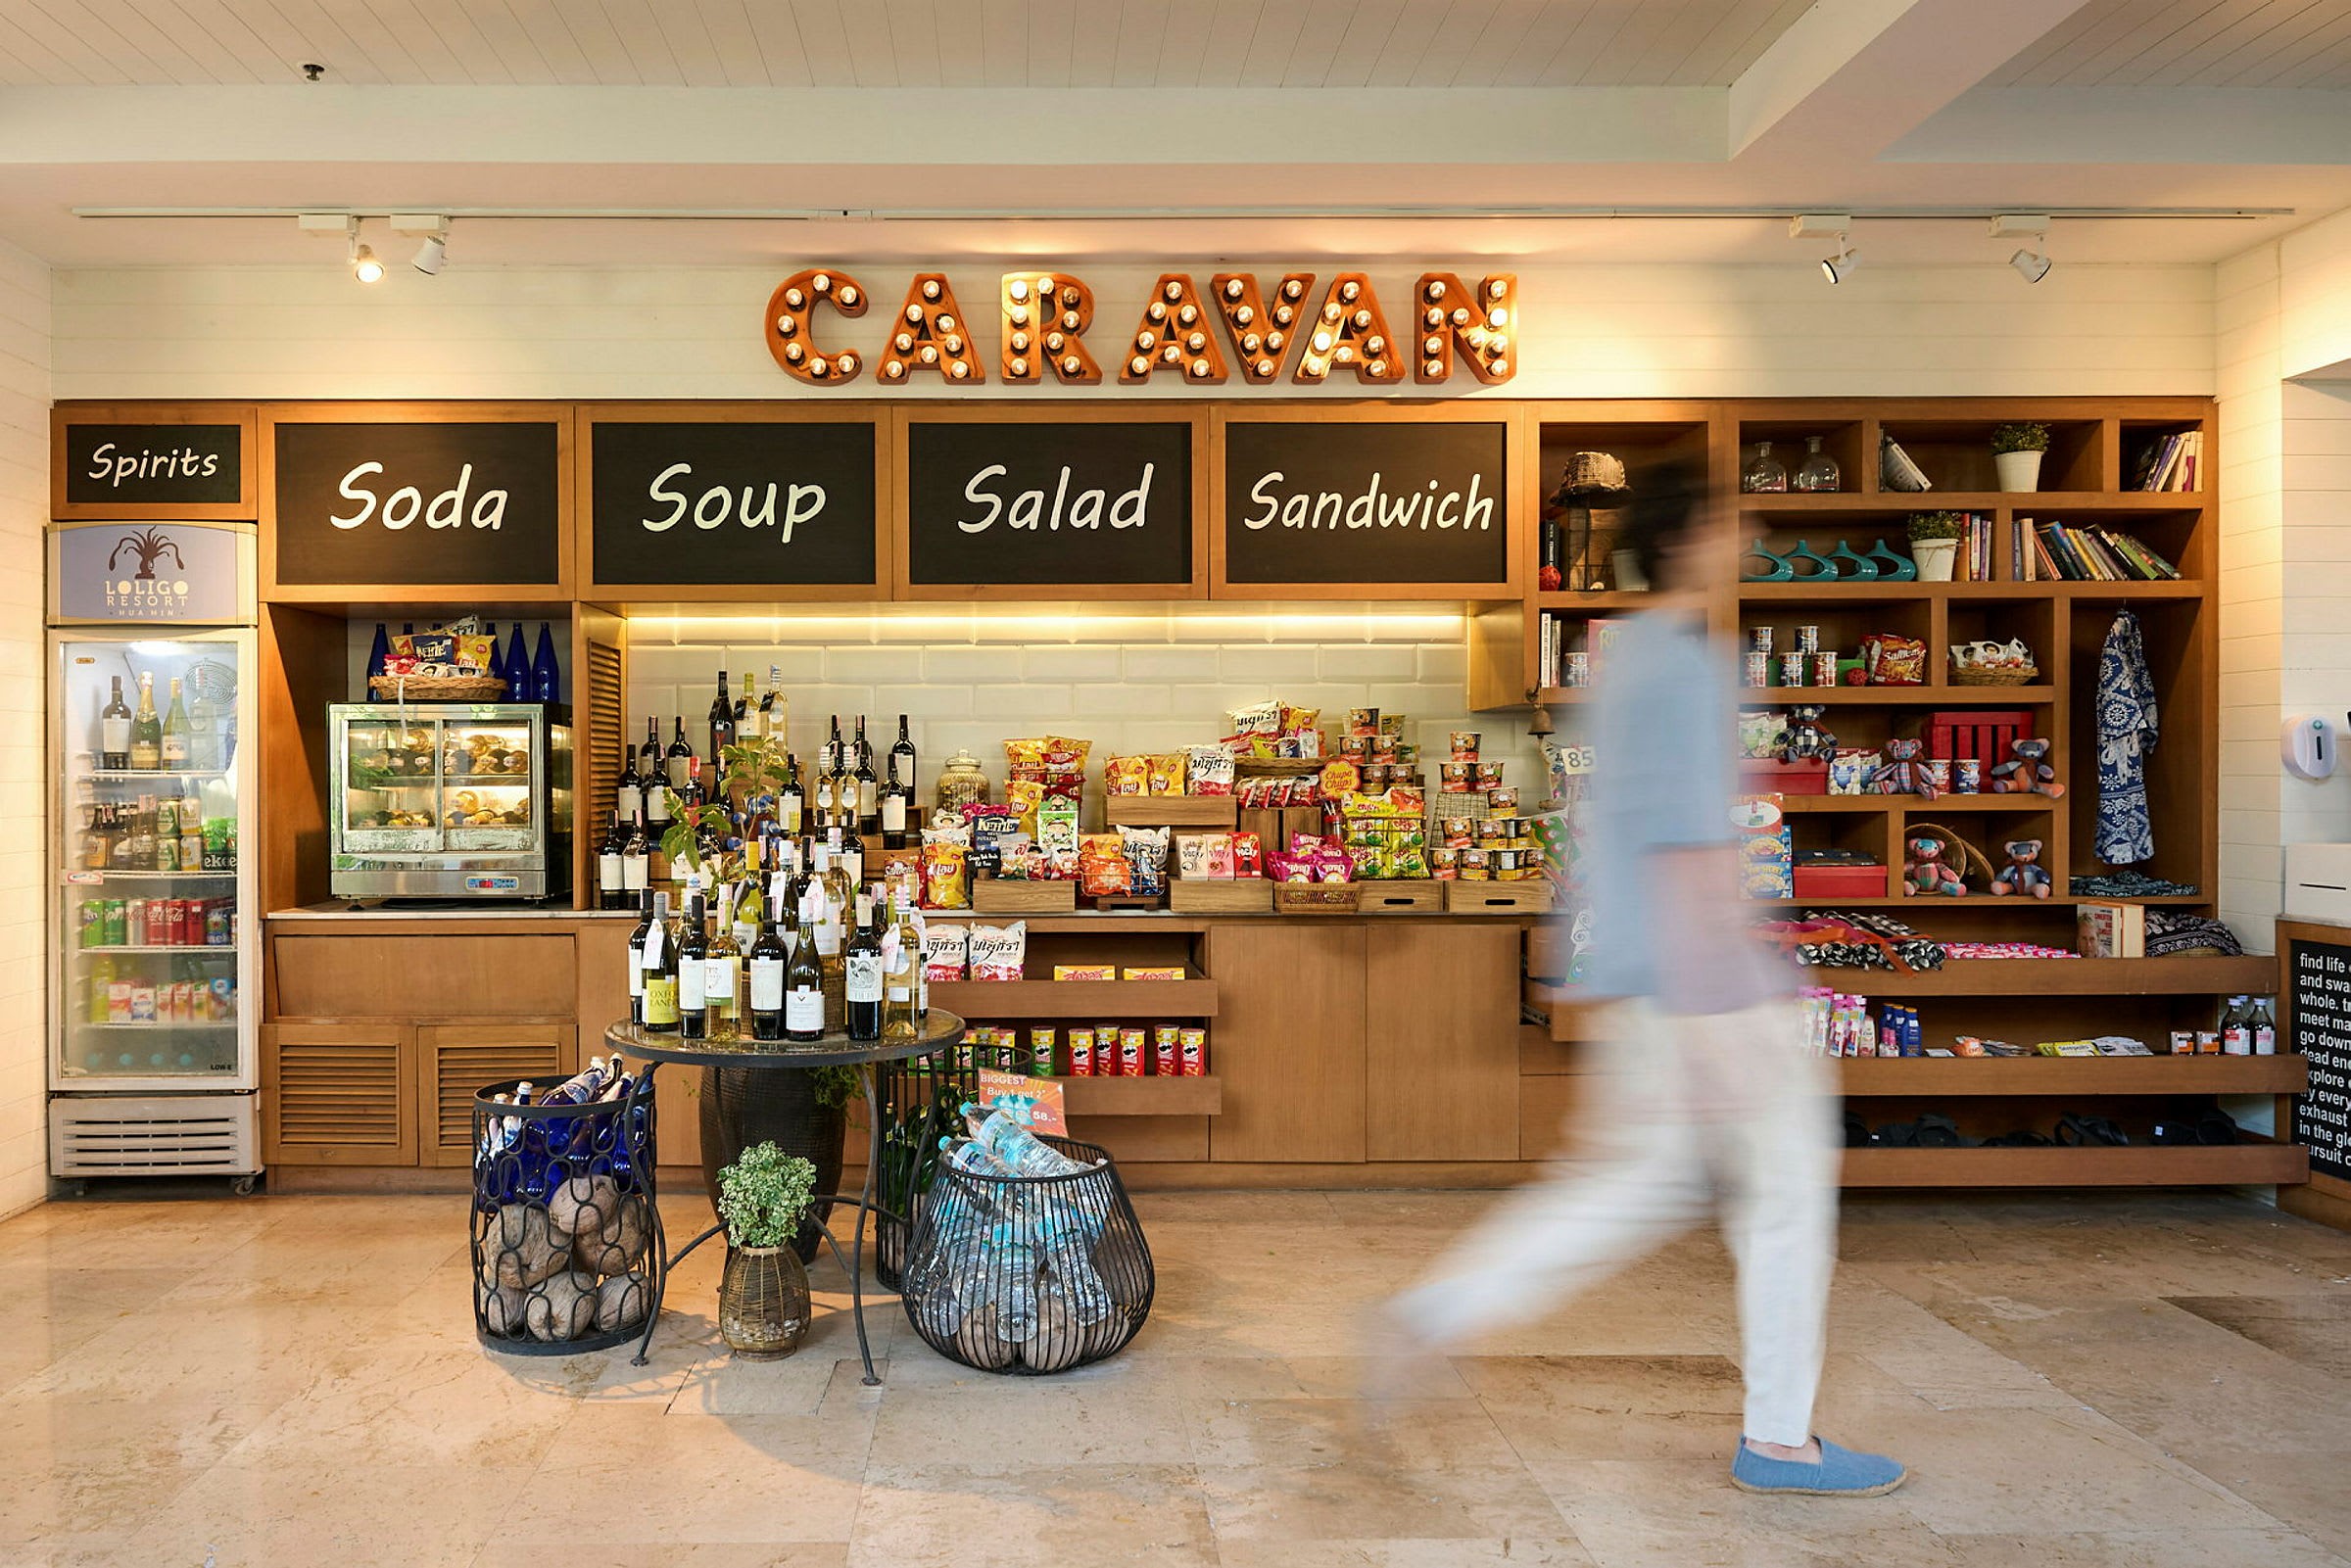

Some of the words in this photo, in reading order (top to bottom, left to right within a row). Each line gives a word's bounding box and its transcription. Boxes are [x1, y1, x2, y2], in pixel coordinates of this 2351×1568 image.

[765, 267, 1517, 386] CARAVAN
[88, 443, 218, 488] Spirits
[329, 461, 508, 531] Soda
[642, 462, 827, 544] Soup
[957, 462, 1155, 534] Salad
[1244, 471, 1494, 531] Sandwich
[105, 579, 190, 594] LOLIGO
[106, 595, 189, 607] RESORT
[1567, 750, 1594, 768] 85
[2299, 952, 2324, 970] find
[2327, 956, 2346, 974] life
[2299, 974, 2323, 989] and
[2299, 991, 2339, 1011] whole.
[2299, 1012, 2330, 1028] meet
[2299, 1030, 2316, 1046] go
[2318, 1030, 2351, 1051] down
[980, 1073, 1028, 1085] BIGGEST
[2308, 1069, 2345, 1088] xplore
[2299, 1104, 2348, 1128] exhaust
[2299, 1119, 2311, 1136] in
[2313, 1123, 2333, 1142] the
